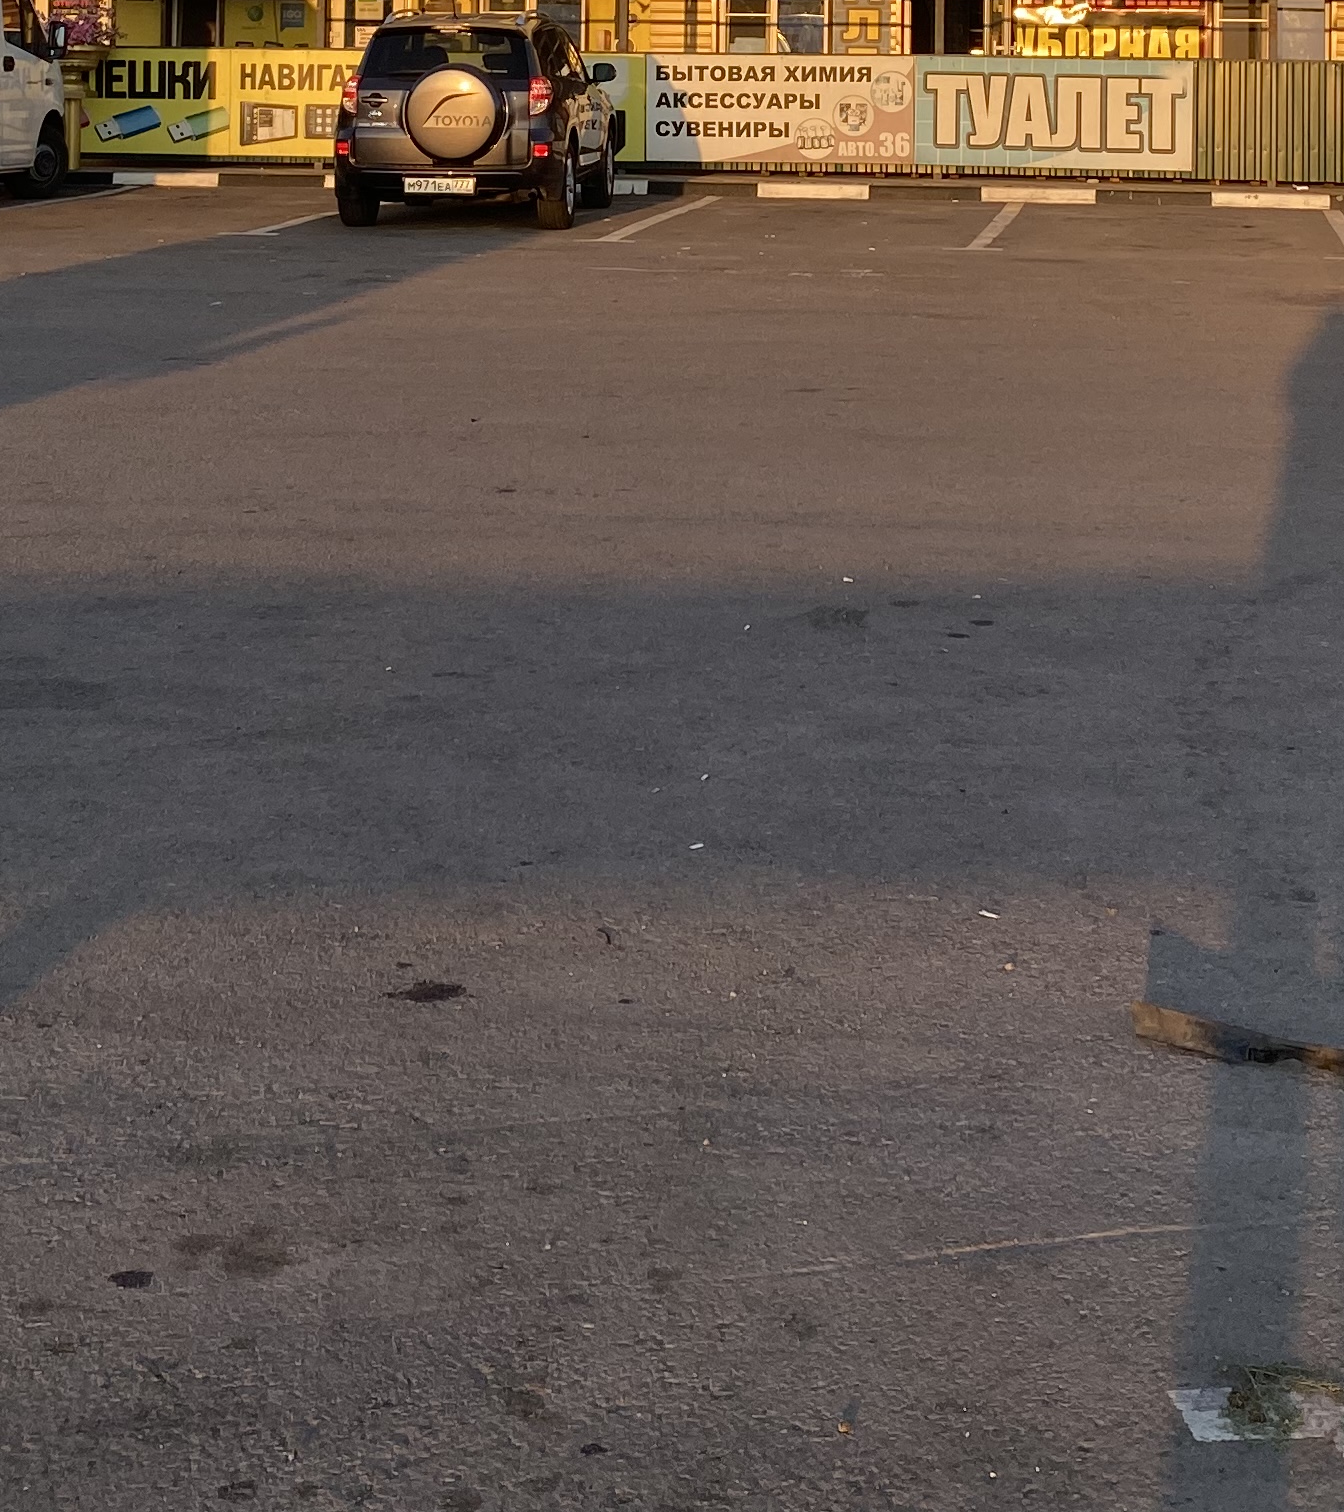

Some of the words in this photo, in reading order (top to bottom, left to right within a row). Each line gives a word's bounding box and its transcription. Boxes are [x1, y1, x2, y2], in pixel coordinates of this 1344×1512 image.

[655, 64, 775, 83] БЫТОВАЯ
[782, 64, 873, 83] ХИМИЯ
[655, 91, 821, 111] АКСЕССУАРЫ
[433, 115, 493, 127] TOYOTA
[923, 73, 1187, 153] ТУАЛЕТ
[655, 120, 790, 139] СУВЕНИРЫ
[838, 132, 911, 158] АВТО.36
[408, 180, 452, 192] М971ЕА
[454, 179, 470, 189] 777
